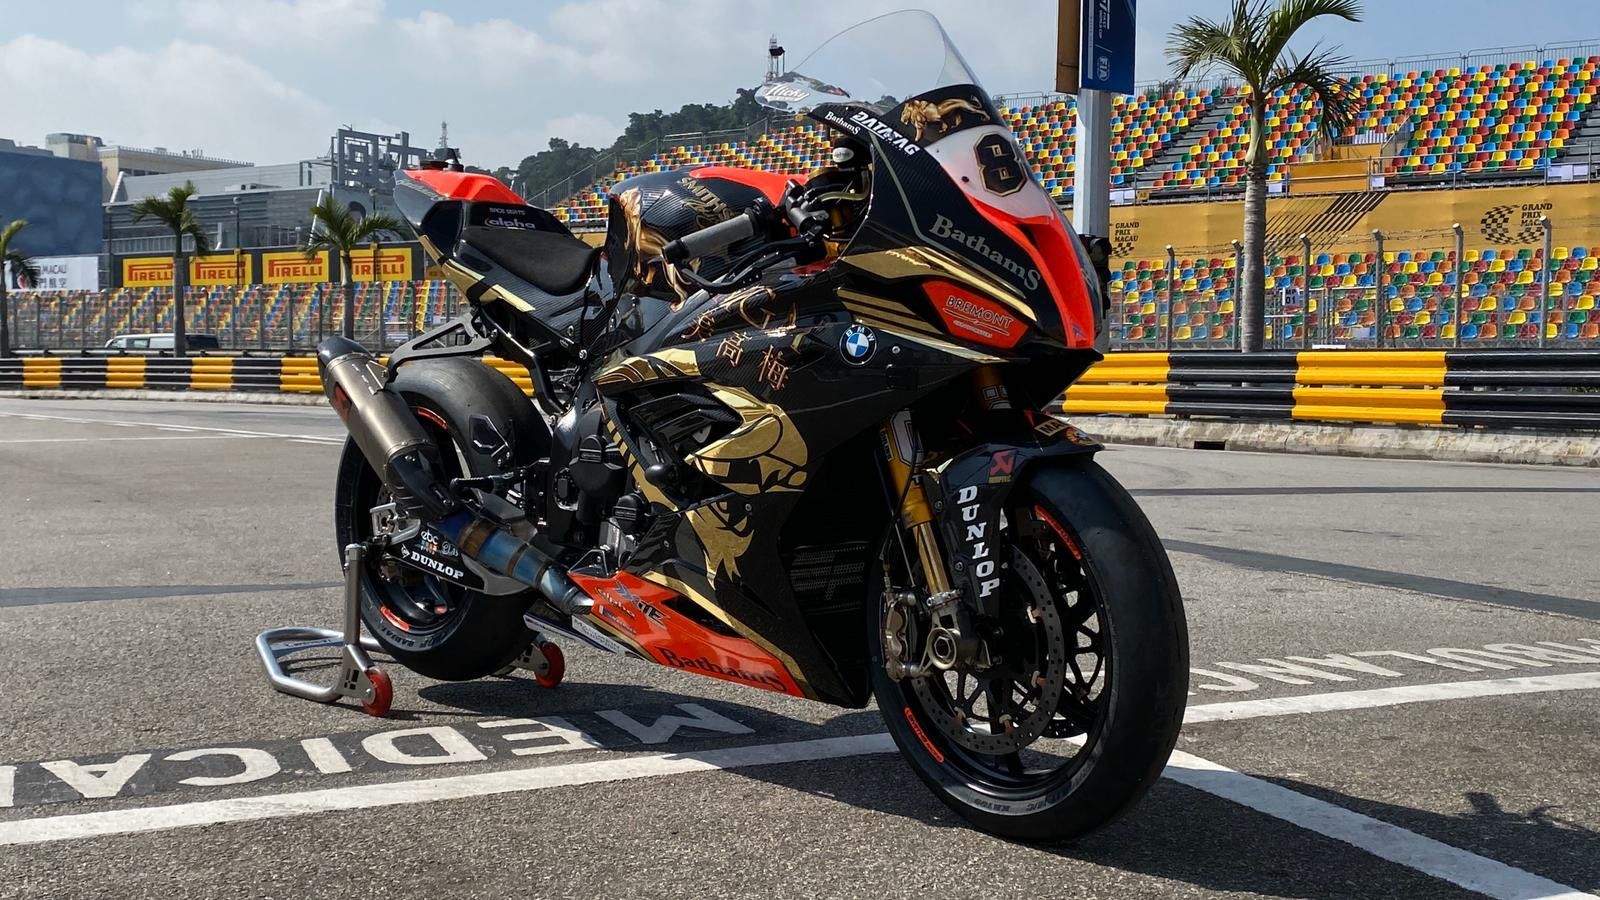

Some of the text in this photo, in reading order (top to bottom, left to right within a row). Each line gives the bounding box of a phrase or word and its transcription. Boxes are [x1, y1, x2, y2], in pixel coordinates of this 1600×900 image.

[1099, 57, 1108, 81] FIA
[853, 111, 919, 156] DATATAG
[974, 131, 1027, 197] 8
[1521, 203, 1553, 211] GRAND
[1521, 211, 1542, 219] PRIX
[485, 217, 536, 230] alpha
[1521, 219, 1542, 227] MAC
[268, 257, 323, 278] PIRELLI
[946, 295, 1014, 328] BREMONT
[845, 326, 875, 341] BMW
[420, 529, 439, 545] ebc
[957, 485, 1000, 598] DUNLOP
[411, 551, 464, 579] DUNLOP
[1187, 638, 1600, 696] BULANC
